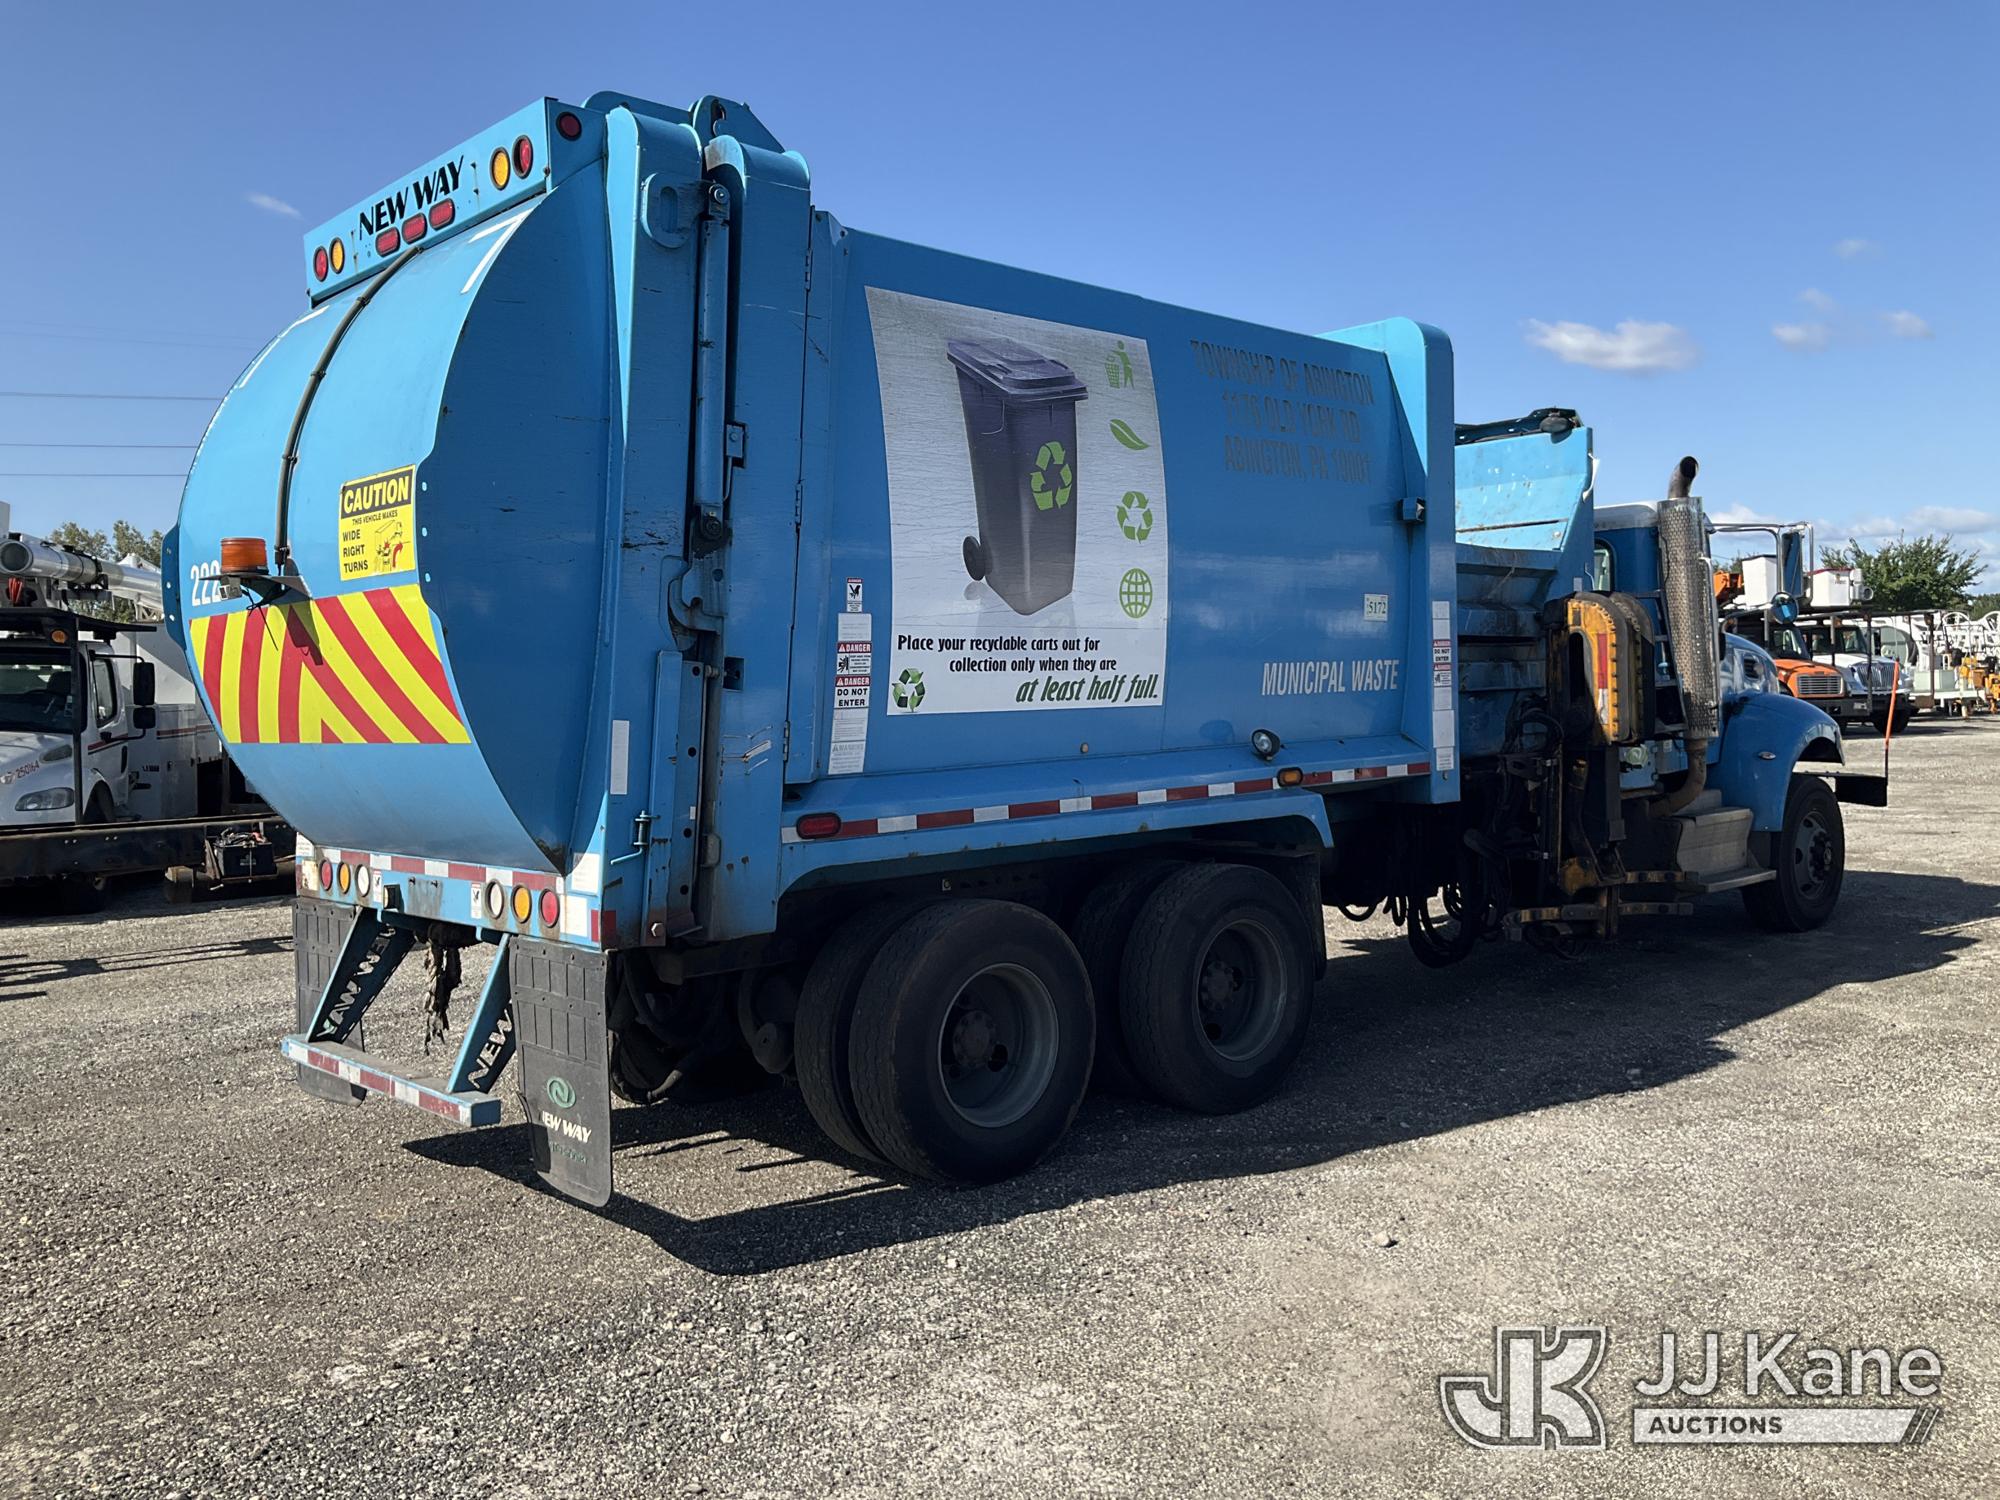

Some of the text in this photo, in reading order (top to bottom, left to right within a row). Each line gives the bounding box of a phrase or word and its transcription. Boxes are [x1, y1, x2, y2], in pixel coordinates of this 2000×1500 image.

[359, 155, 464, 241] NEW WAY
[1279, 356, 1299, 391] OF
[1303, 362, 1375, 406] ABINGTON
[343, 476, 409, 514] CAUTION
[363, 513, 382, 524] VEHICLE
[382, 509, 398, 519] MAKES
[342, 529, 361, 542] WIDE
[343, 544, 365, 558] RIGHT
[344, 560, 368, 573] TURNS
[845, 643, 871, 652] DANGER
[898, 634, 1101, 653] Place your recyclable carts out for
[949, 656, 1117, 673] collection only when they are
[844, 677, 869, 686] DANGER
[1262, 659, 1400, 696] MUNICIPAL WASTE
[837, 688, 868, 696] DO NOT
[1015, 674, 1159, 703] at least half full.
[838, 699, 865, 707] ENTER
[467, 1008, 512, 1089] NEW
[542, 1110, 592, 1144] EW WAY
